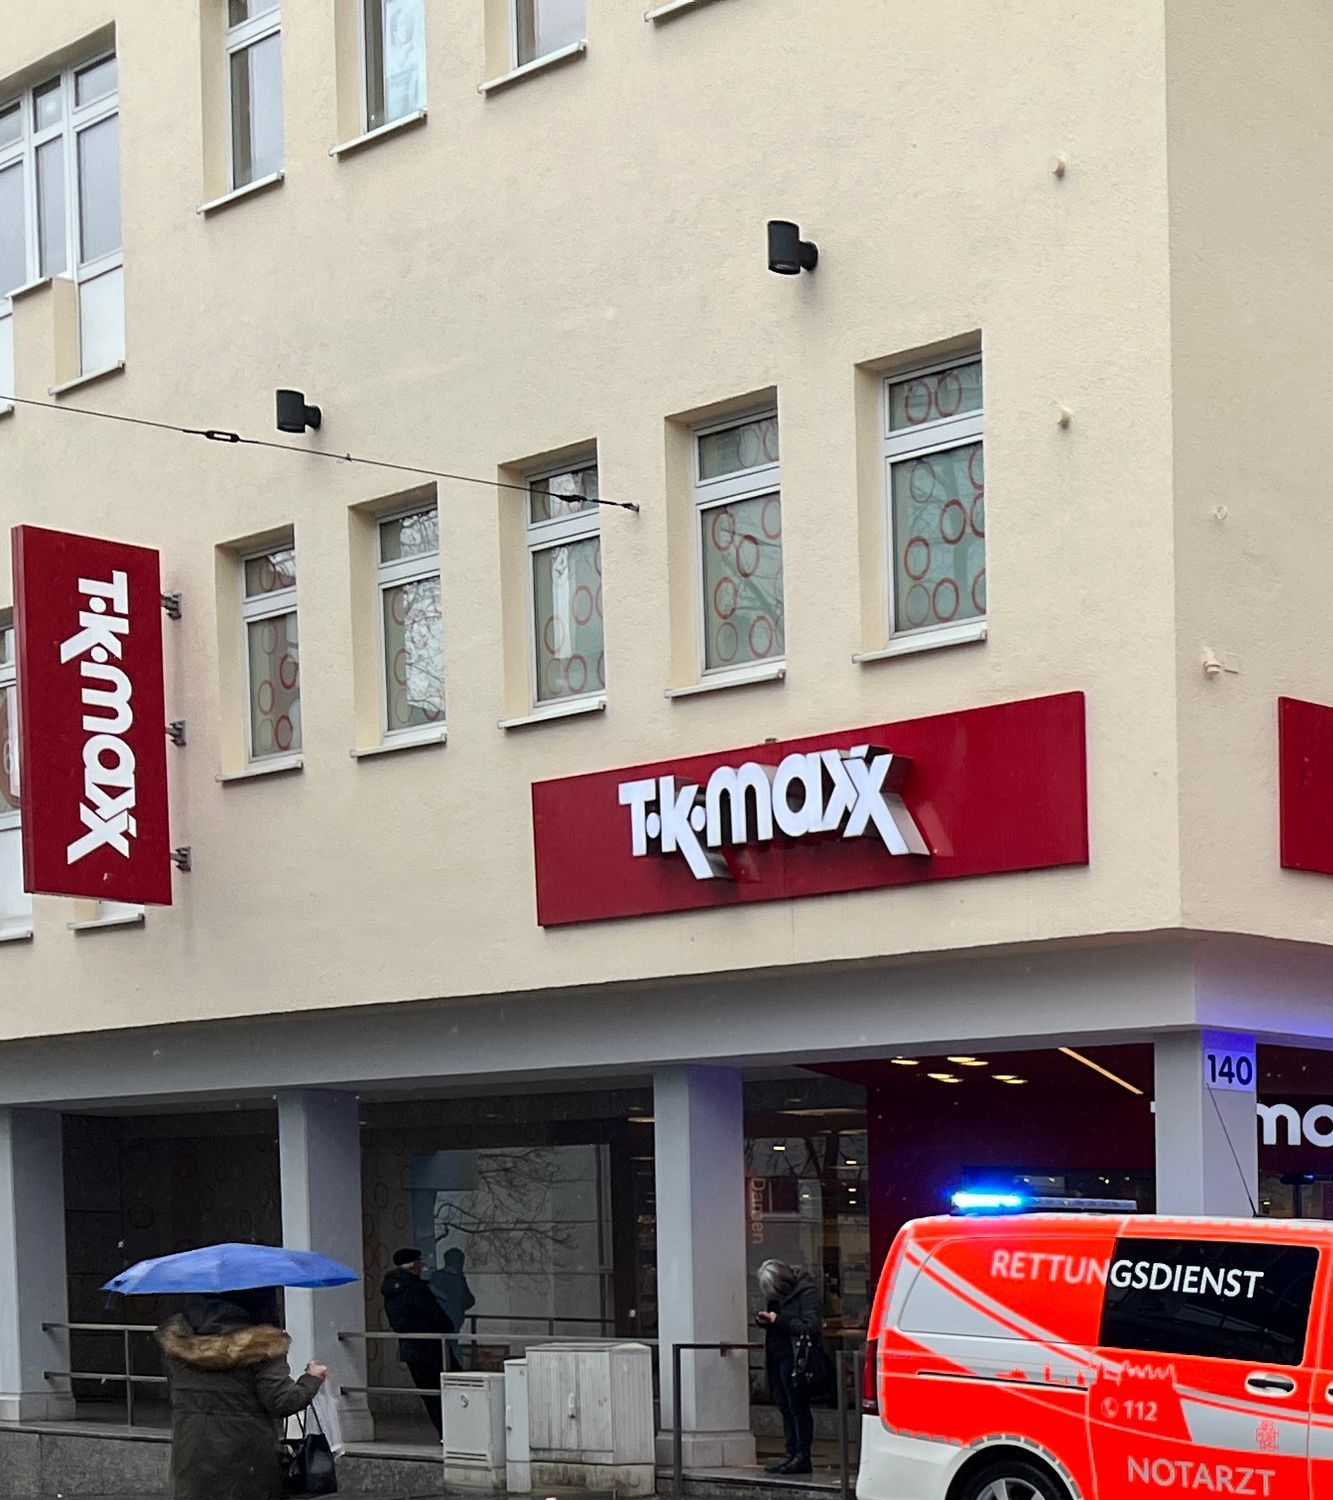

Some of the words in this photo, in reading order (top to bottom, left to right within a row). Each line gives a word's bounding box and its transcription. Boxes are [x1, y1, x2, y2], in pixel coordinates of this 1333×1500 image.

[1207, 1054, 1253, 1086] 140
[750, 1177, 766, 1244] Damen
[990, 1249, 1265, 1299] RETTUNGSDIENST
[1123, 1399, 1158, 1422] 112
[1126, 1455, 1276, 1497] NOTARZT
